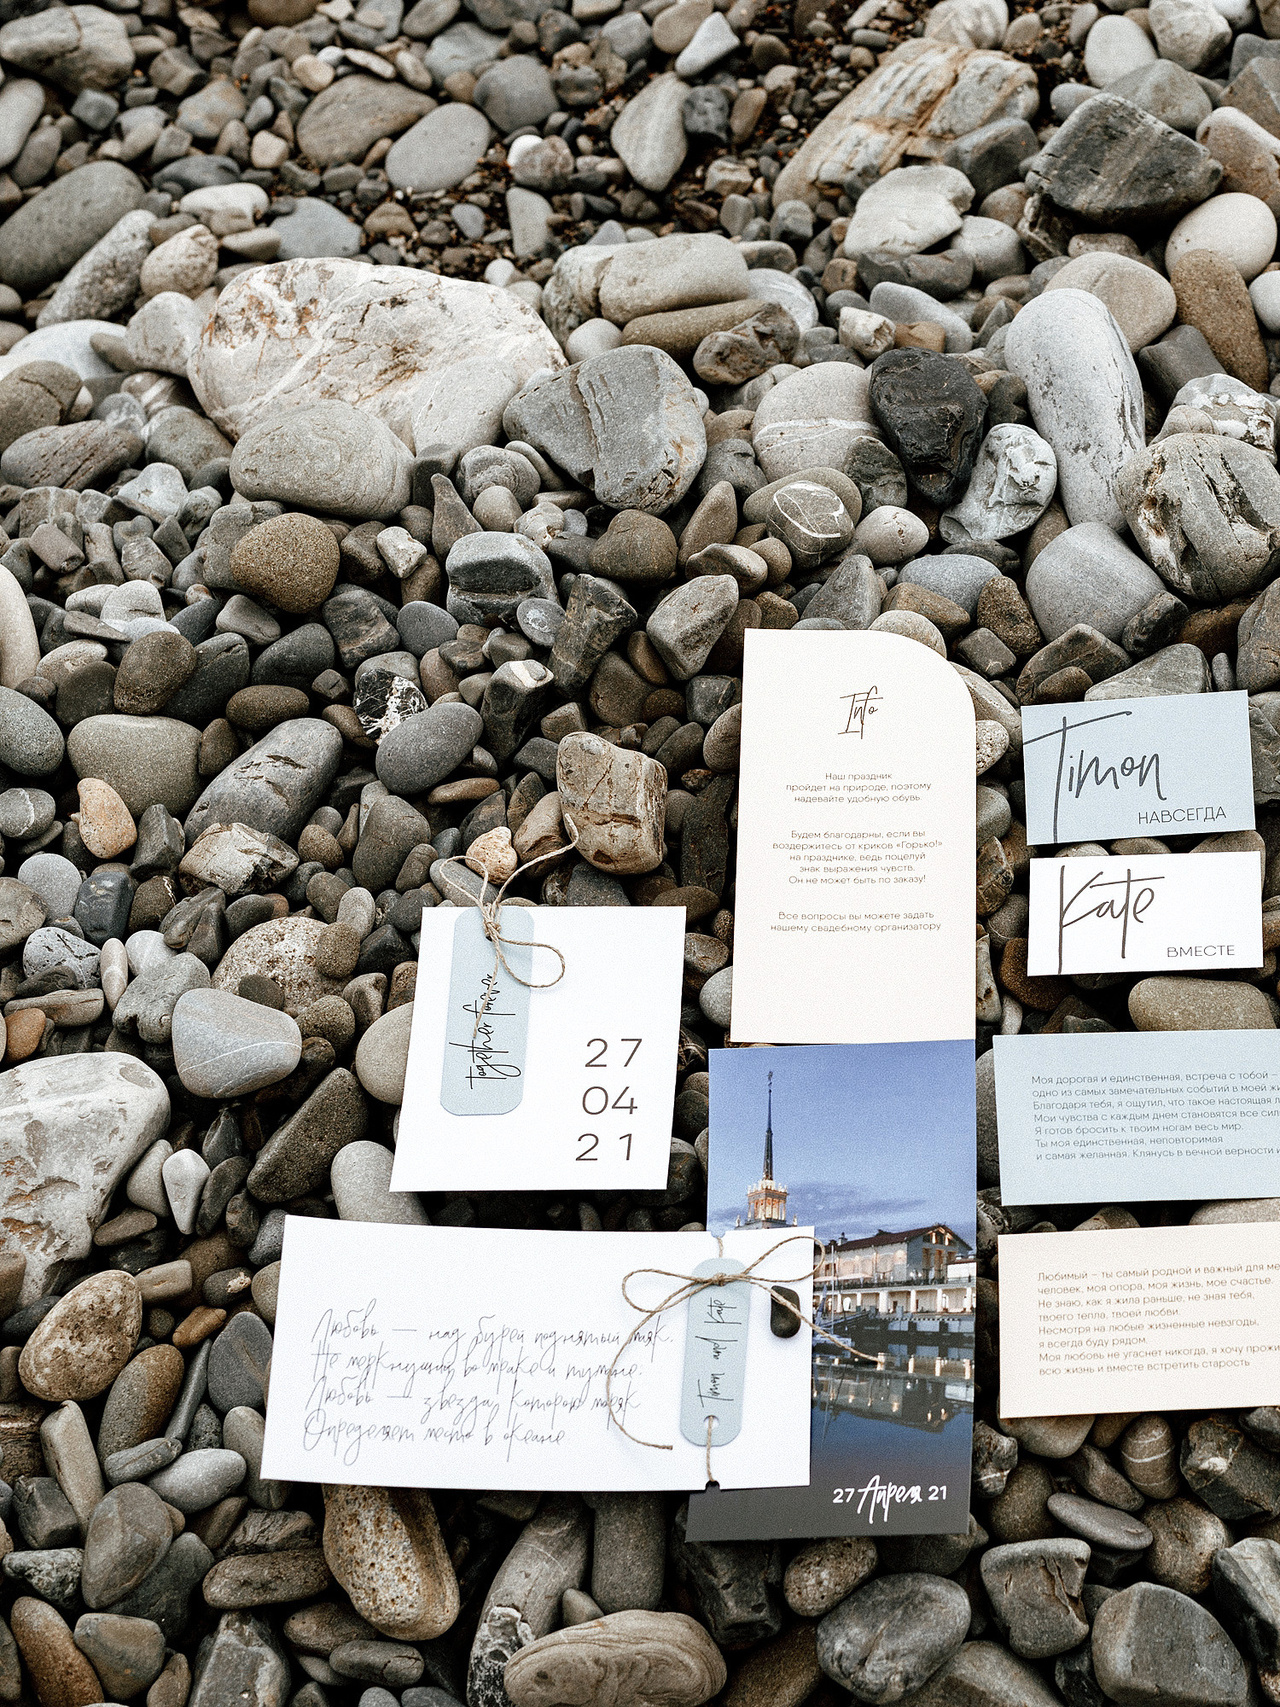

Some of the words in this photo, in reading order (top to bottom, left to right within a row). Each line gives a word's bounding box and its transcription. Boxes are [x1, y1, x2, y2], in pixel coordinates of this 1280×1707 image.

[837, 685, 884, 740] Info
[826, 772, 846, 780] Наш
[848, 772, 892, 781] праздник
[1023, 711, 1167, 843] Timon
[786, 784, 827, 792] пройдет
[843, 784, 888, 792] природе,
[891, 783, 931, 791] поэтому
[794, 795, 844, 803] надевайте
[848, 795, 889, 804] удобную
[892, 794, 922, 802] обувь.
[1137, 806, 1227, 825] НАВСЕГДА
[791, 830, 820, 839] Будем
[824, 831, 883, 840] благодарны,
[772, 842, 842, 851] воздержитесь
[858, 842, 893, 851] криков
[896, 840, 942, 850] «Горько!»
[803, 854, 857, 863] празднике,
[859, 854, 882, 862] ведь
[885, 852, 926, 861] поцелуй
[823, 865, 878, 874] выражения
[880, 865, 915, 873] чувств.
[789, 876, 803, 884] Он
[853, 876, 876, 884] быть
[893, 875, 926, 885] заказу!
[778, 911, 798, 920] Все
[801, 912, 846, 921] вопросы
[864, 912, 900, 920] можете
[903, 911, 934, 920] задать
[1058, 865, 1165, 975] Kate
[770, 924, 808, 933] нашему
[811, 924, 872, 932] свадебному
[874, 923, 941, 932] организатору
[1167, 945, 1236, 958] ВМЕСТЕ
[585, 1038, 643, 1068] 27
[1031, 1075, 1054, 1084] Моя
[1055, 1075, 1099, 1086] дорогая
[1109, 1073, 1183, 1083] единственная,
[1185, 1072, 1227, 1082] встреча
[1239, 1070, 1269, 1080] тобой
[1032, 1089, 1059, 1098] одно
[1074, 1088, 1106, 1097] самых
[1108, 1086, 1184, 1096] замечательных
[1186, 1084, 1230, 1094] событий
[1240, 1083, 1267, 1092] моей
[582, 1085, 638, 1115] 04
[1033, 1100, 1087, 1111] Благодаря
[1125, 1099, 1166, 1109] ощутил,
[1188, 1098, 1216, 1106] такое
[1218, 1096, 1272, 1106] настоящая
[1034, 1114, 1057, 1123] Мои
[1059, 1113, 1099, 1123] чувства
[1110, 1112, 1150, 1121] каждым
[1152, 1112, 1179, 1121] днем
[1181, 1110, 1238, 1119] становятся
[1044, 1127, 1073, 1135] готов
[1075, 1126, 1119, 1136] бросить
[1129, 1125, 1160, 1133] твоим
[1162, 1124, 1192, 1132] ногам
[1194, 1123, 1219, 1131] весь
[575, 1133, 633, 1161] 21
[1073, 1138, 1147, 1148] единственная,
[1149, 1136, 1224, 1145] неповторимая
[1045, 1152, 1076, 1160] самая
[1132, 1149, 1174, 1158] Клянусь
[1185, 1148, 1222, 1157] вечной
[1224, 1147, 1274, 1157] верности
[703, 1297, 742, 1325] Kate
[694, 1335, 738, 1360] and
[696, 1372, 735, 1408] Timon
[832, 1488, 854, 1503] 27
[928, 1485, 948, 1500] 21
